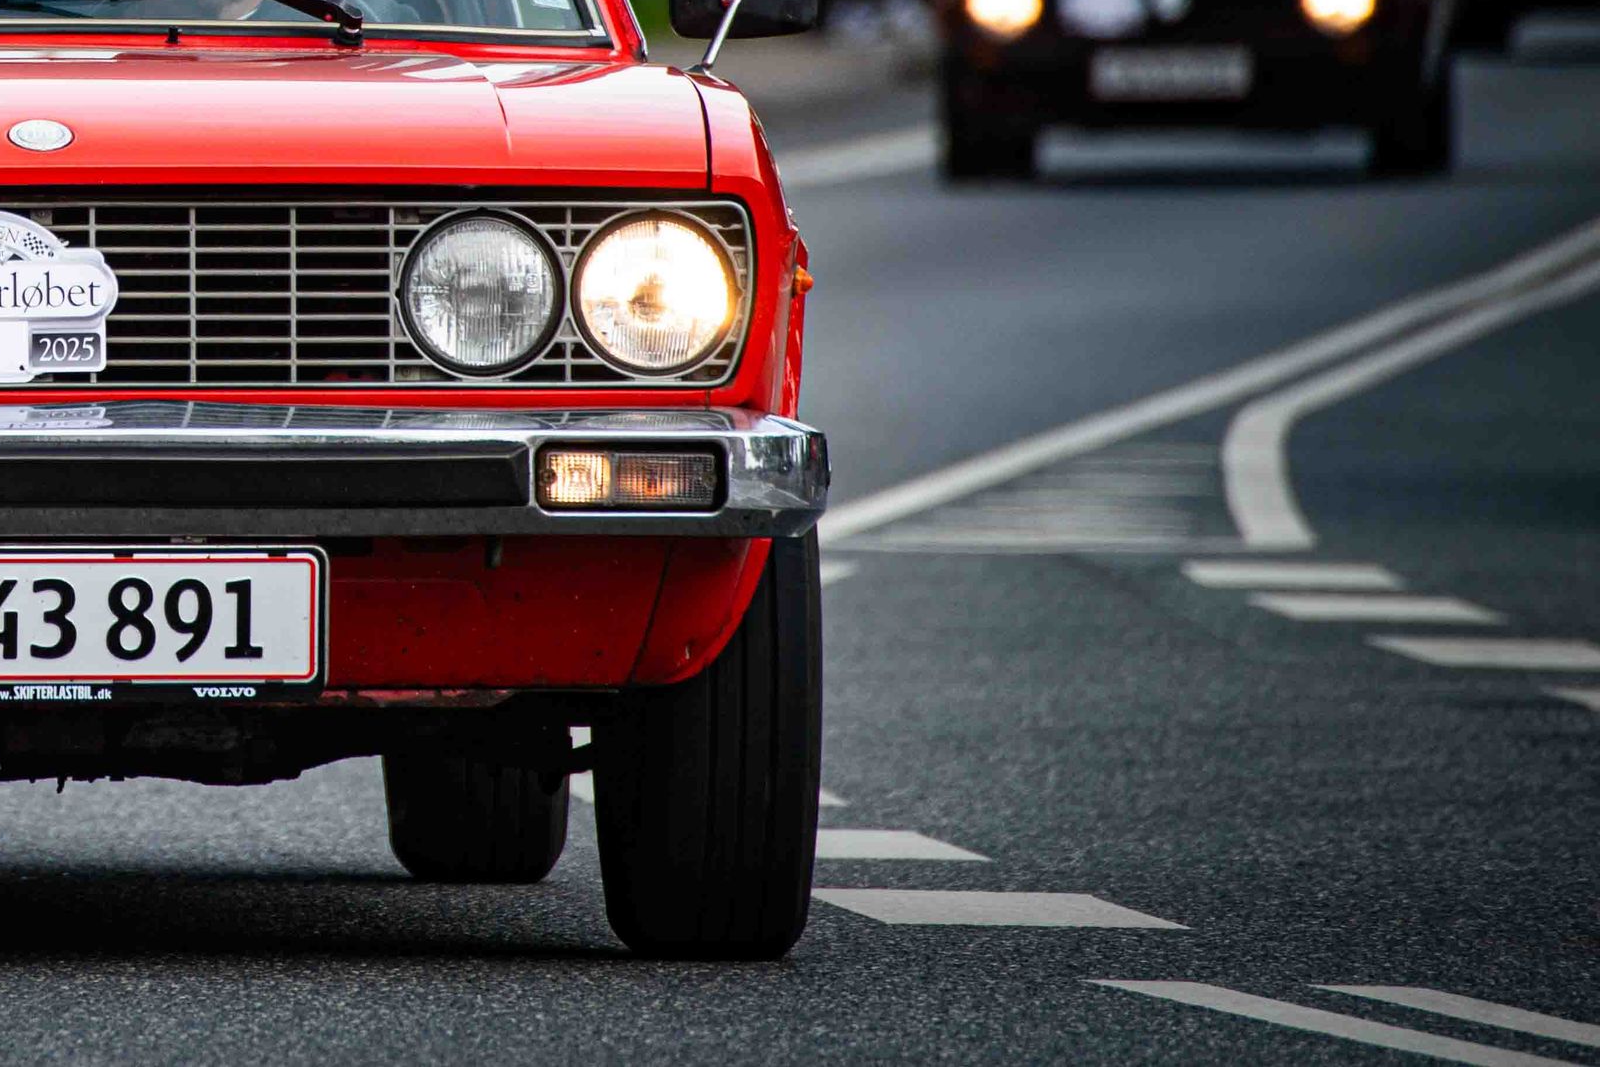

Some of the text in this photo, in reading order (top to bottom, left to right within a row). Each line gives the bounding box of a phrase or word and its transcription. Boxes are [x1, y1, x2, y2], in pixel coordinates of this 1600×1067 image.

[39, 337, 95, 362] 2025
[106, 577, 263, 663] 891
[192, 687, 257, 698] VOLVO
